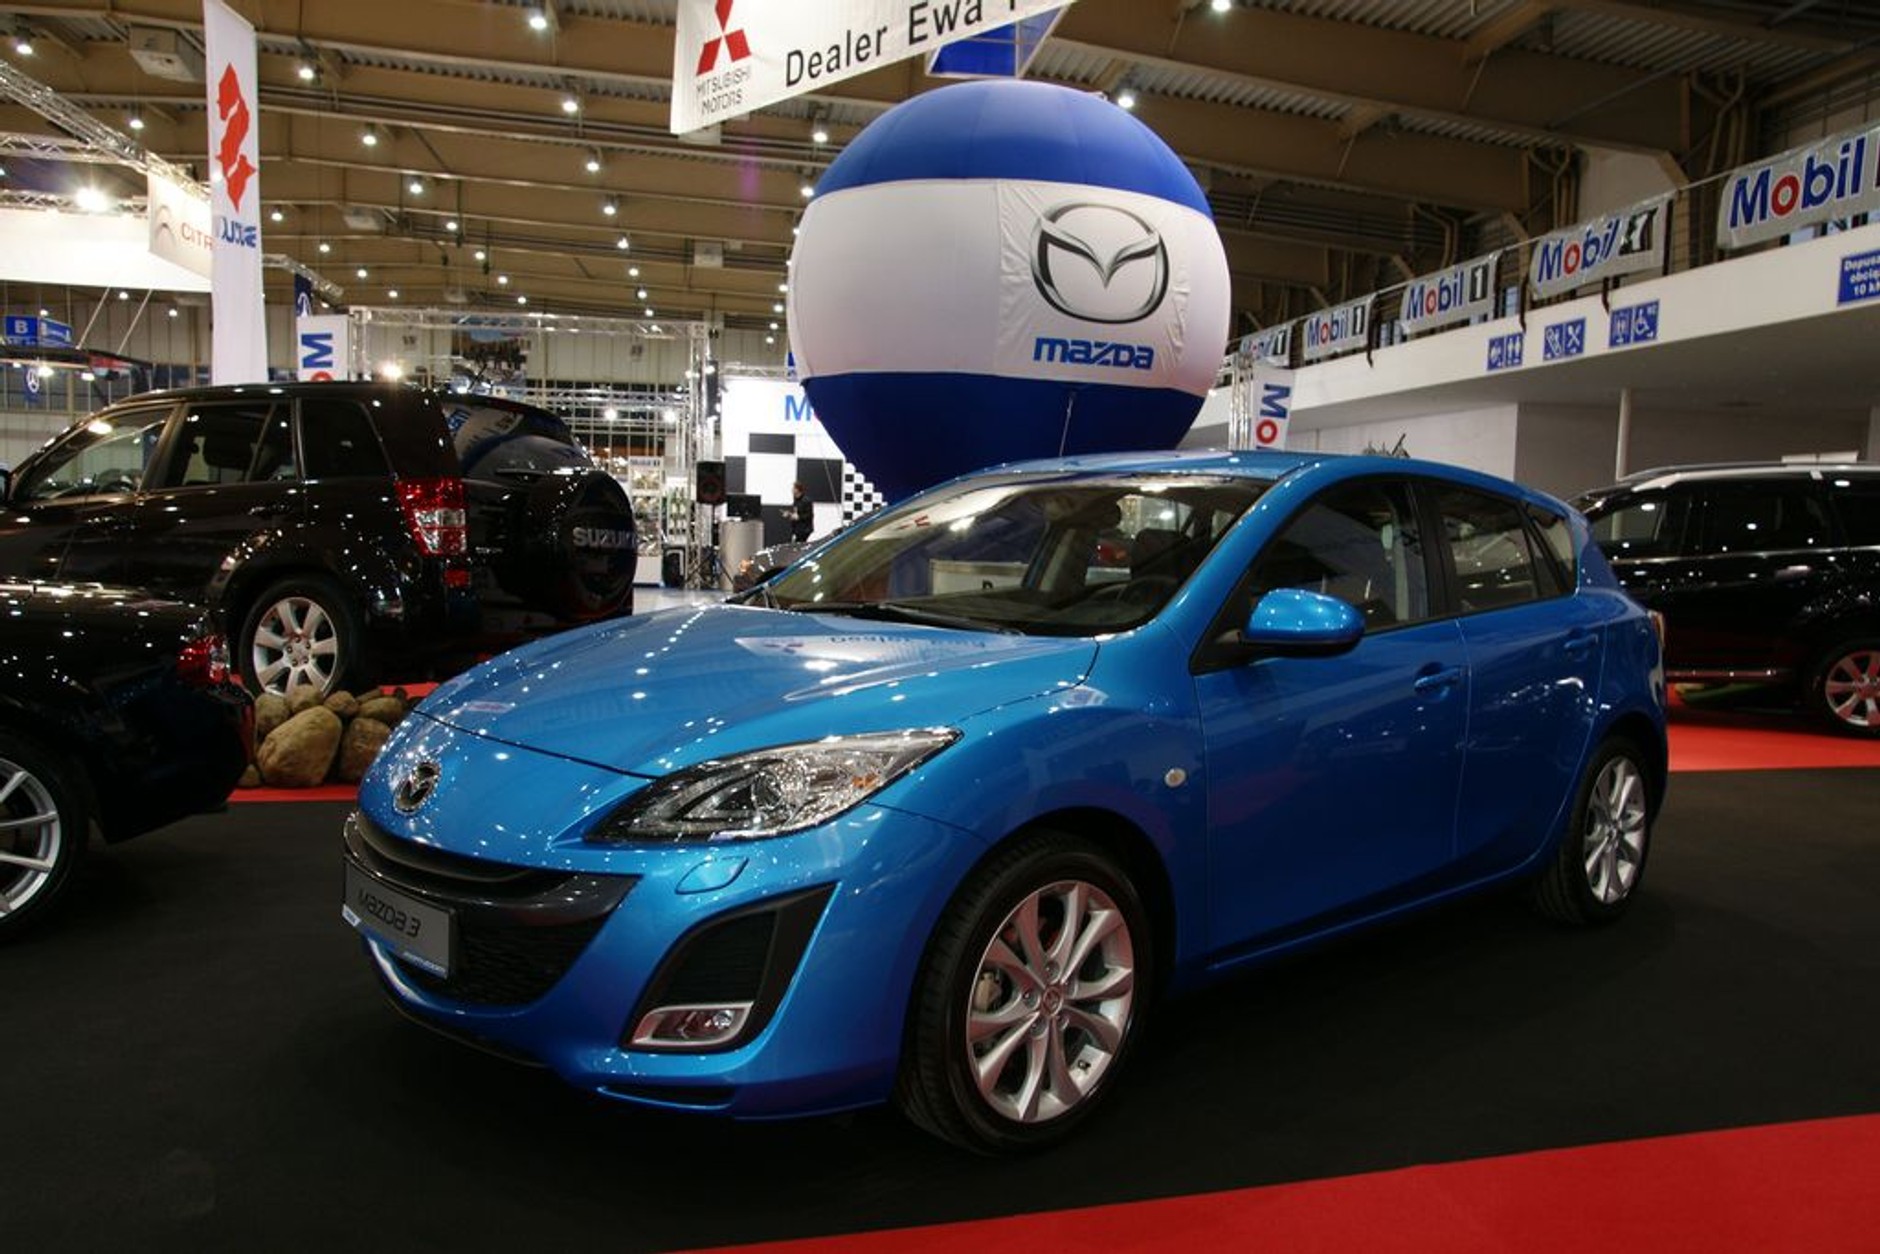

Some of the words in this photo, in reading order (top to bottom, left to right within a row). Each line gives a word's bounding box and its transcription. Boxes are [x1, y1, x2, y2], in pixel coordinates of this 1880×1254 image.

[786, 25, 888, 87] Dealer
[908, 0, 982, 46] Ewa
[696, 65, 751, 97] MITSUBISHI
[702, 87, 742, 115] MOTORS
[1729, 136, 1866, 228] Mobil
[1538, 218, 1622, 283] Mobil
[1406, 271, 1464, 320] Mobil
[15, 320, 28, 333] B
[1307, 309, 1349, 348] Mobil
[406, 916, 421, 938] 3
